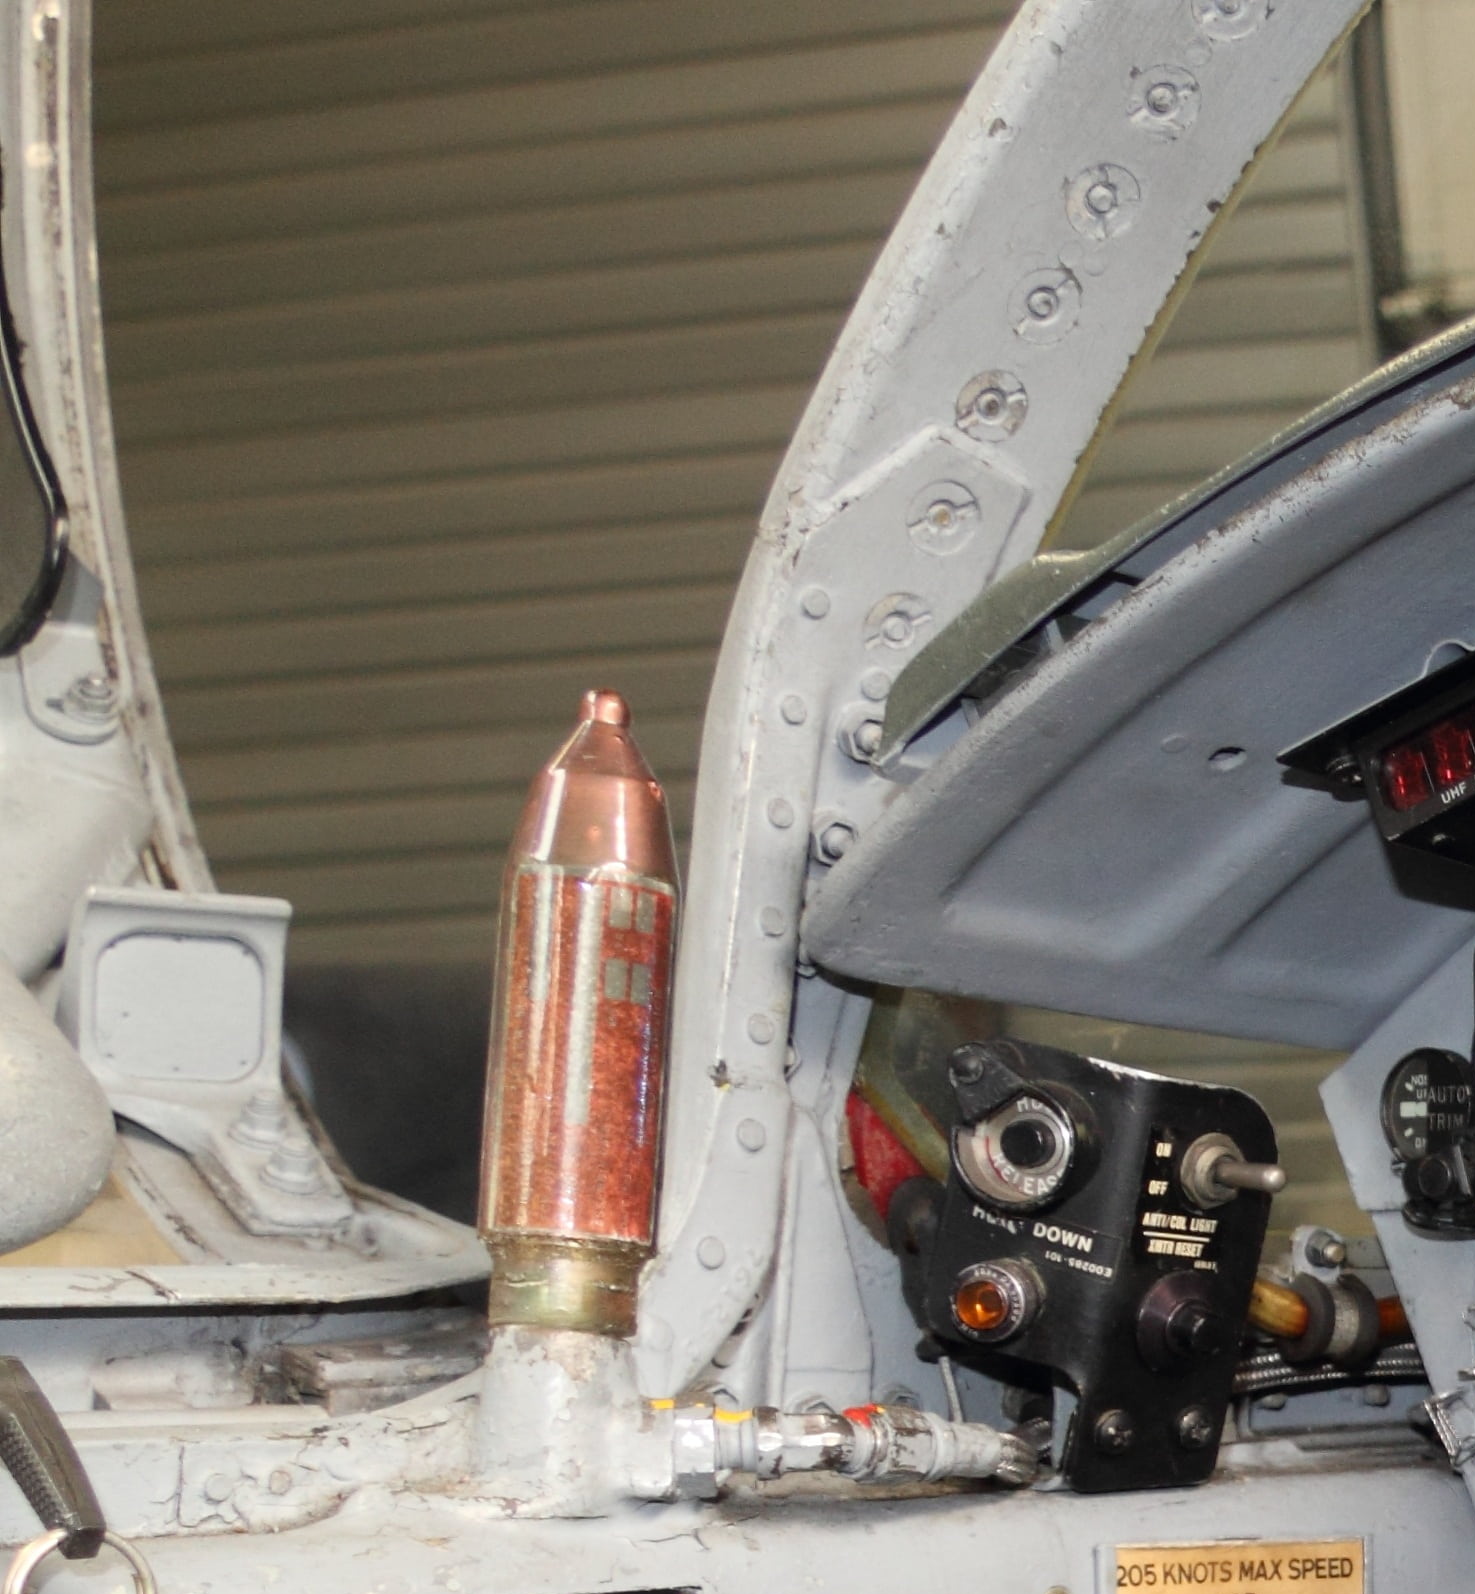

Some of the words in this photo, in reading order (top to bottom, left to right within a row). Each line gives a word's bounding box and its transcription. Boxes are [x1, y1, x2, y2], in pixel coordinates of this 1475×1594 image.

[1440, 783, 1468, 806] UHF
[1033, 1223, 1093, 1253] DOWN
[1117, 1564, 1157, 1587] 205
[1163, 1561, 1232, 1584] KNOTS
[1239, 1559, 1283, 1581] MAX
[1288, 1558, 1353, 1580] SPEED
